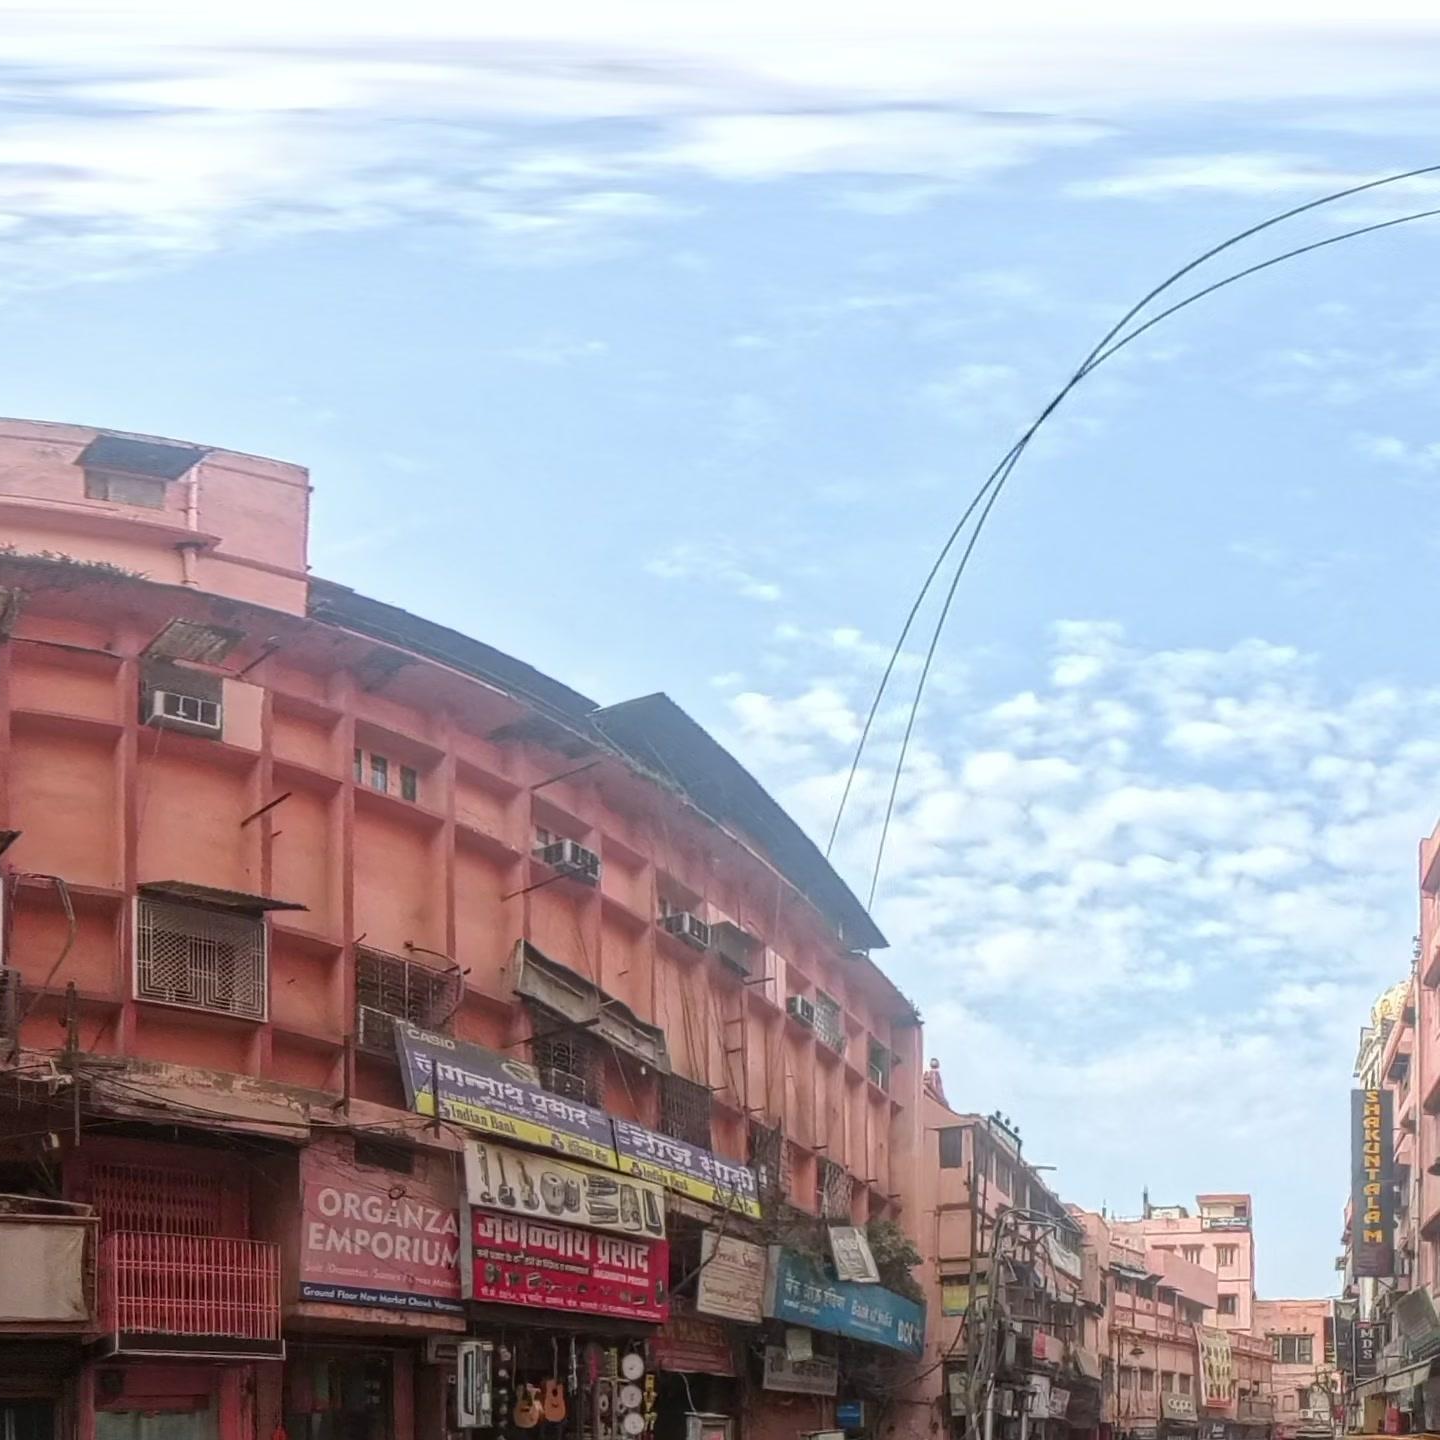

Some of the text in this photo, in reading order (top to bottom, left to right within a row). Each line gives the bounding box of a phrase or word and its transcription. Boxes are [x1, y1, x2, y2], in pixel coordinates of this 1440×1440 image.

[406, 1028, 456, 1050] CASIO
[451, 1103, 488, 1127] Indian
[491, 1115, 516, 1135] Bank
[529, 1092, 590, 1130] प्रसाद
[1362, 1090, 1383, 1243] SHAKUNTALAM
[318, 1187, 459, 1238] ORGANZA
[308, 1222, 461, 1270] EMPORIUM
[595, 1234, 651, 1273] प्रसाद
[303, 1286, 335, 1298] Ground
[337, 1288, 358, 1300] Floor
[360, 1291, 378, 1301] New
[380, 1293, 407, 1305] Market
[1360, 1327, 1375, 1360] MDS
